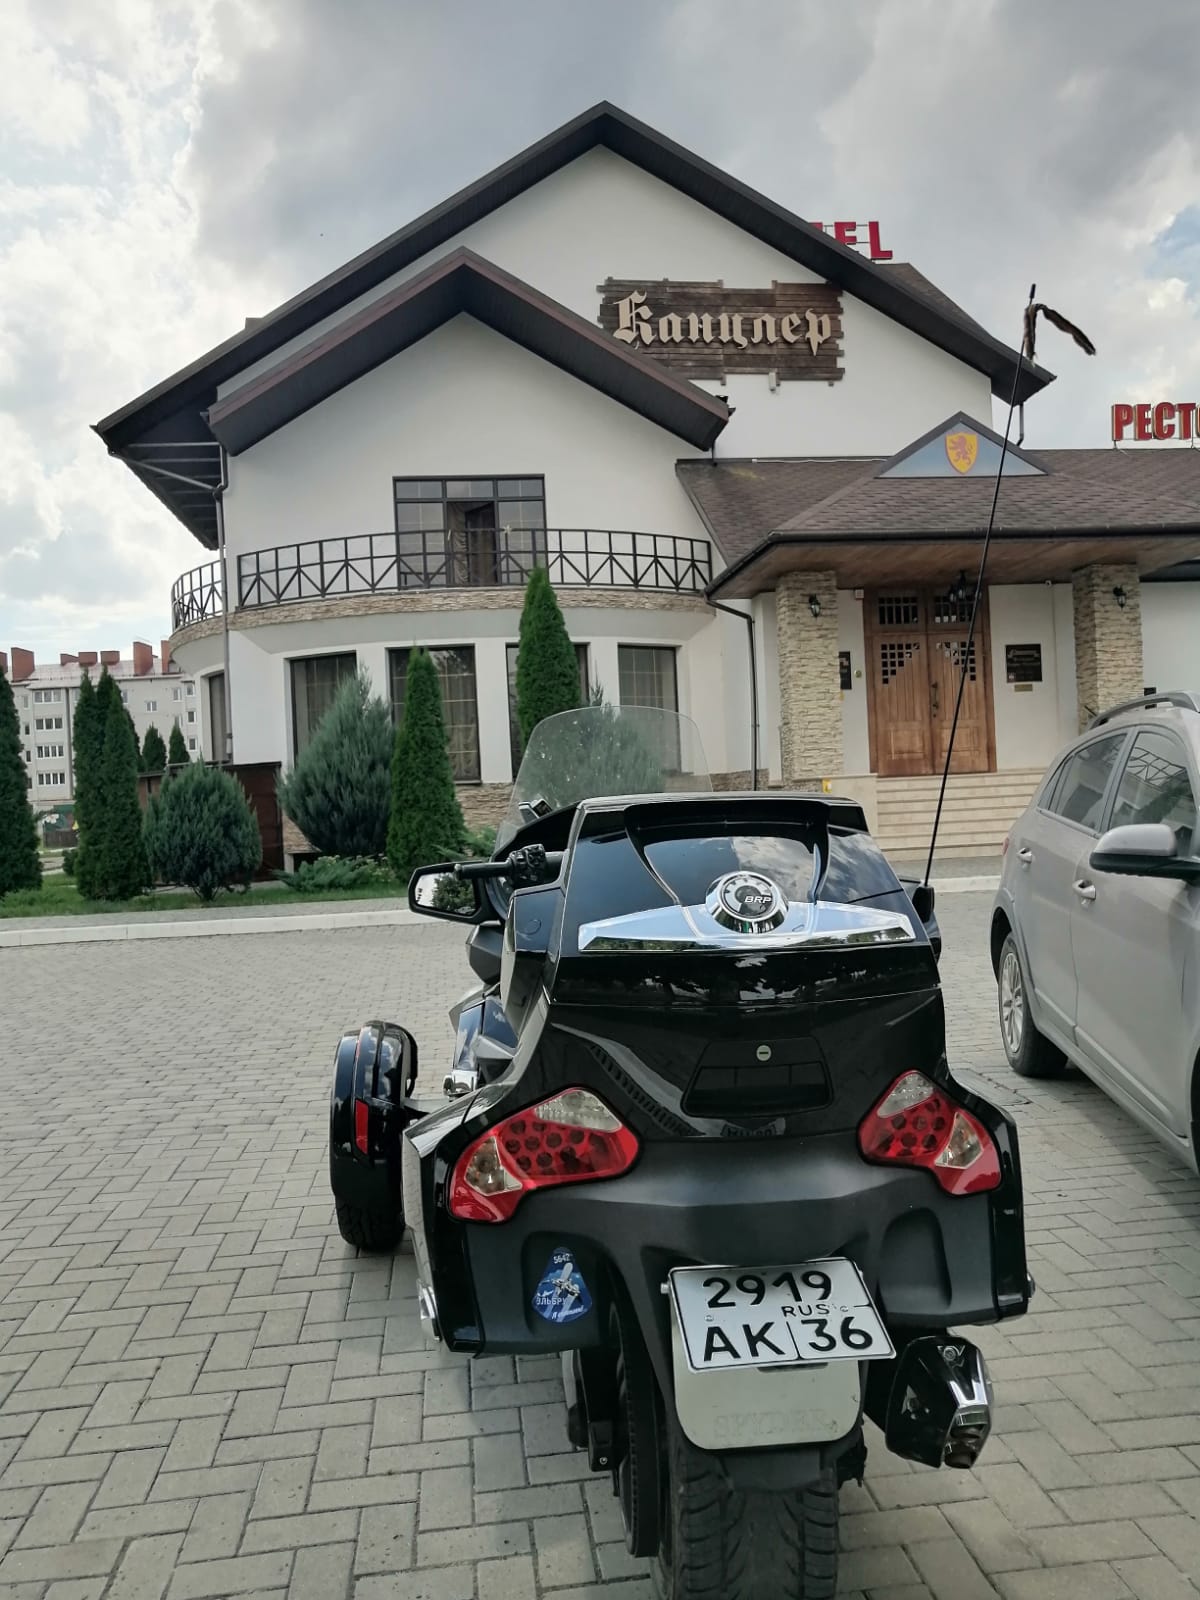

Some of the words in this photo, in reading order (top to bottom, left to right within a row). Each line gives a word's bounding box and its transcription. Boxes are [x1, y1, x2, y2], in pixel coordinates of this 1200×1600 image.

[807, 221, 893, 260] EL
[612, 290, 832, 356] Канцлер
[1112, 402, 1200, 441] РЕСТ
[744, 896, 772, 904] BRP
[702, 1270, 832, 1309] 2919
[781, 1303, 830, 1317] RUS
[801, 1316, 873, 1352] 36
